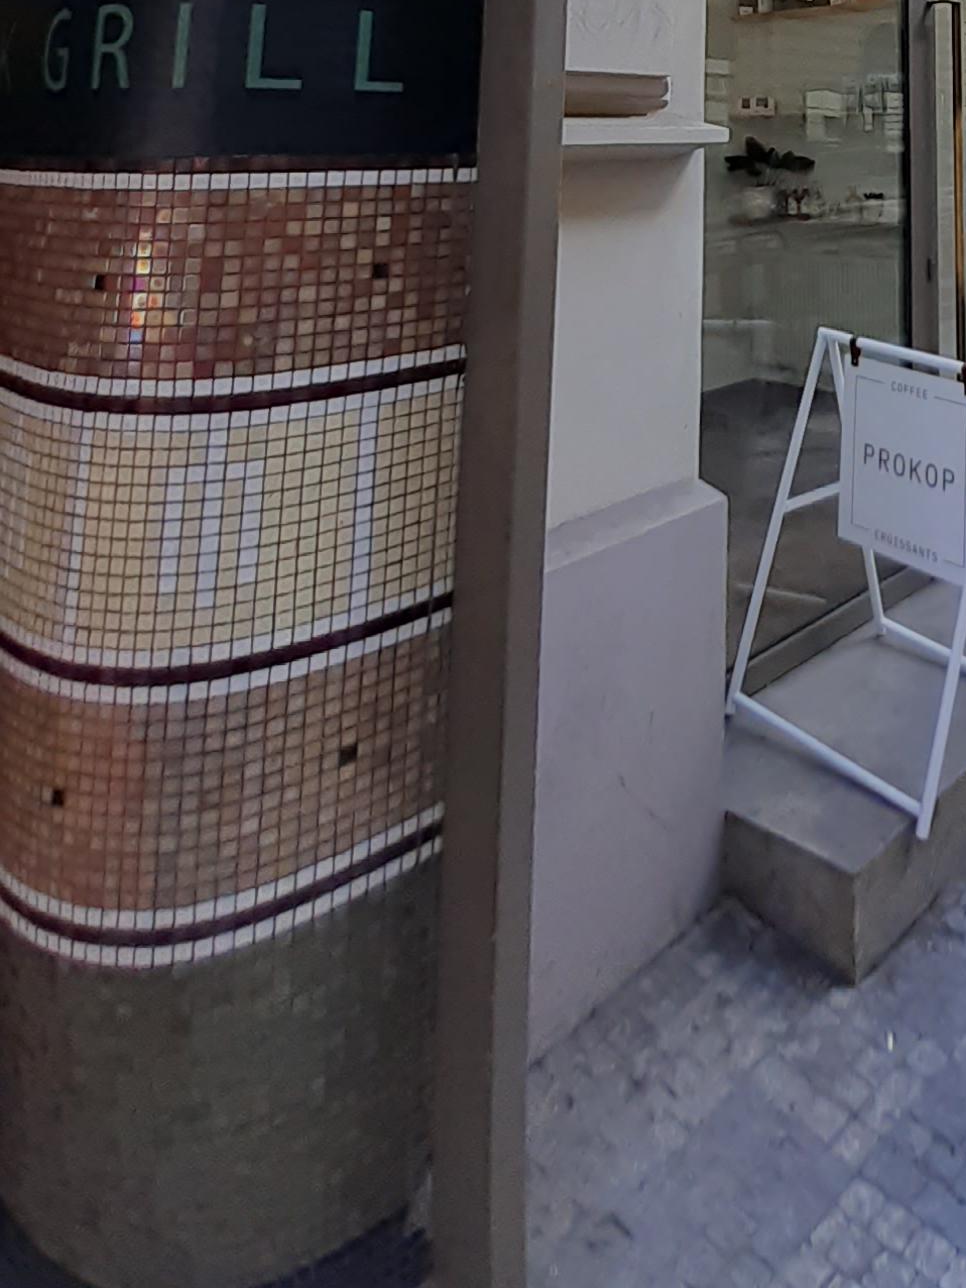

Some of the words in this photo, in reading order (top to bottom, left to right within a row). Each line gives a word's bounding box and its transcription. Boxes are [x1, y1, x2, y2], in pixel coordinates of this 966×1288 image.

[43, 2, 404, 93] GRILL
[891, 380, 928, 401] COFFEE
[863, 442, 956, 493] PROKOP
[874, 528, 939, 562] CROISSANTS
